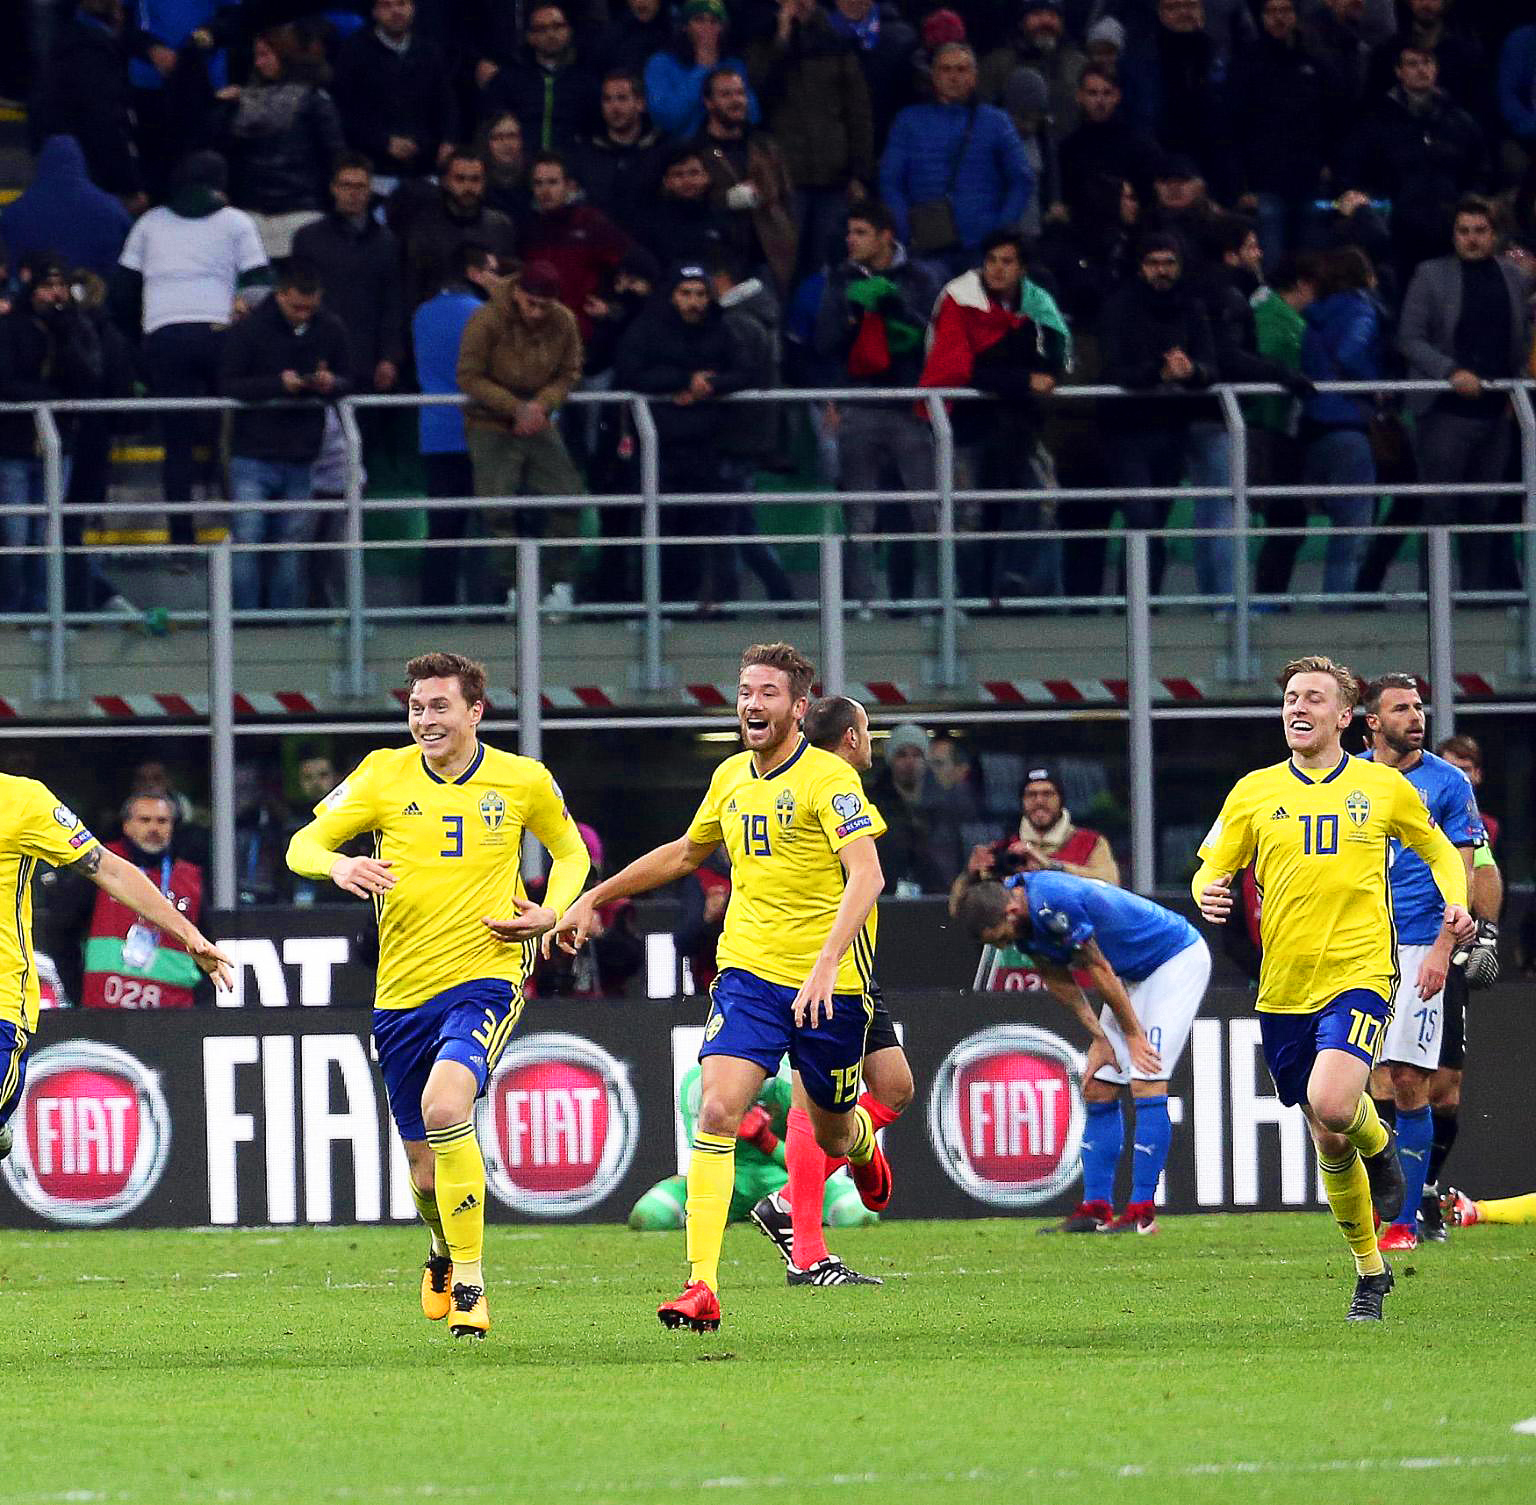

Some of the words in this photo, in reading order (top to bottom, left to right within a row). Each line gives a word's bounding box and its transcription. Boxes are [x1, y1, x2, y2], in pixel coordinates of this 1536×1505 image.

[440, 816, 464, 858] 3
[741, 814, 772, 857] 19
[1298, 815, 1339, 855] 10
[471, 1007, 497, 1050] 3
[1346, 1007, 1382, 1057] 10
[1414, 1007, 1440, 1043] 15
[830, 1066, 860, 1105] 19
[36, 1096, 132, 1175] FIAT
[505, 1087, 601, 1168] FIAT
[969, 1078, 1064, 1158] FIAT
